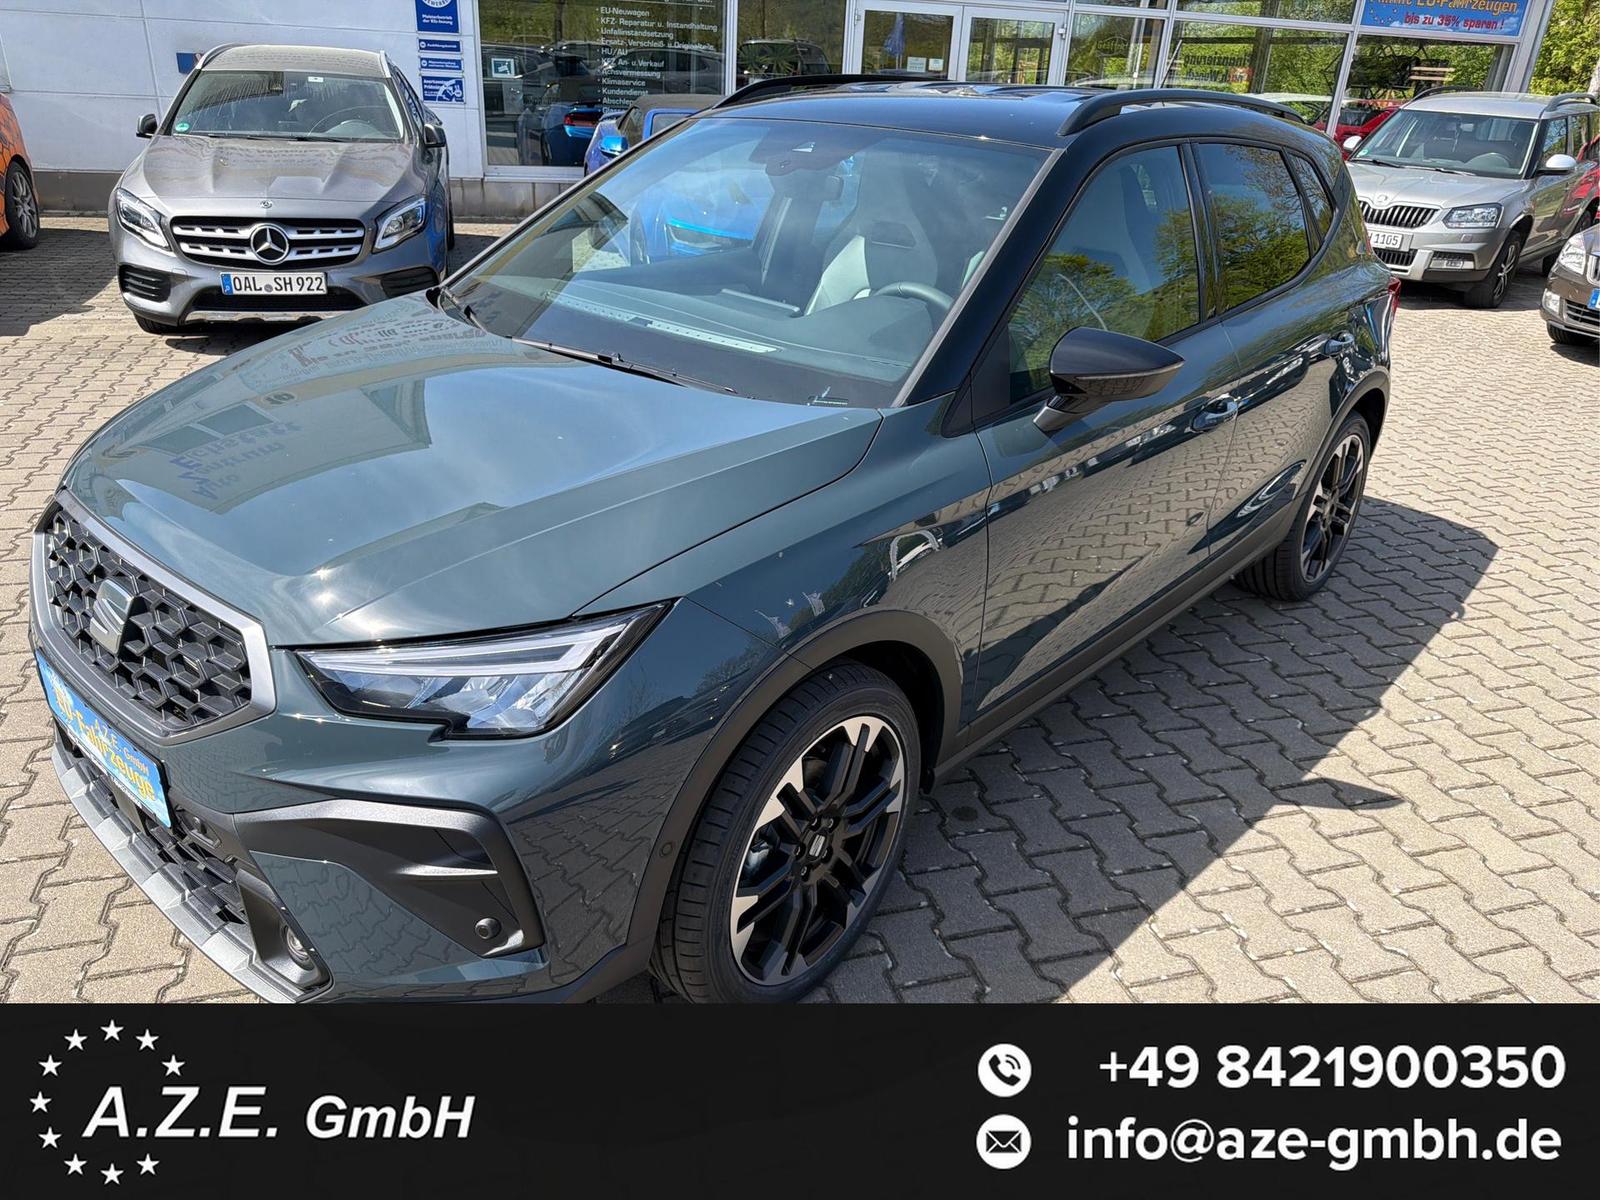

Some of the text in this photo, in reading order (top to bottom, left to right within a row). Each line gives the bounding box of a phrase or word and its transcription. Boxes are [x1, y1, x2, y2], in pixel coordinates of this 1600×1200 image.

[600, 6, 650, 17] EU-Neuwagen
[600, 17, 618, 25] KFZ-
[619, 18, 656, 28] Reparatur
[666, 21, 718, 32] Instandhaltung
[1404, 12, 1419, 24] bis
[1422, 16, 1434, 25] zu
[1437, 14, 1460, 27] 35%
[1463, 17, 1498, 30] sparen
[600, 28, 674, 39] Unfallinstandsetzung
[601, 48, 628, 56] HU/AU
[601, 69, 661, 79] Achsvermessung
[602, 78, 646, 87] Klimaservice
[602, 87, 649, 96] Kundendienst
[1374, 233, 1399, 246] 1105
[233, 276, 325, 292] OAL SH 922
